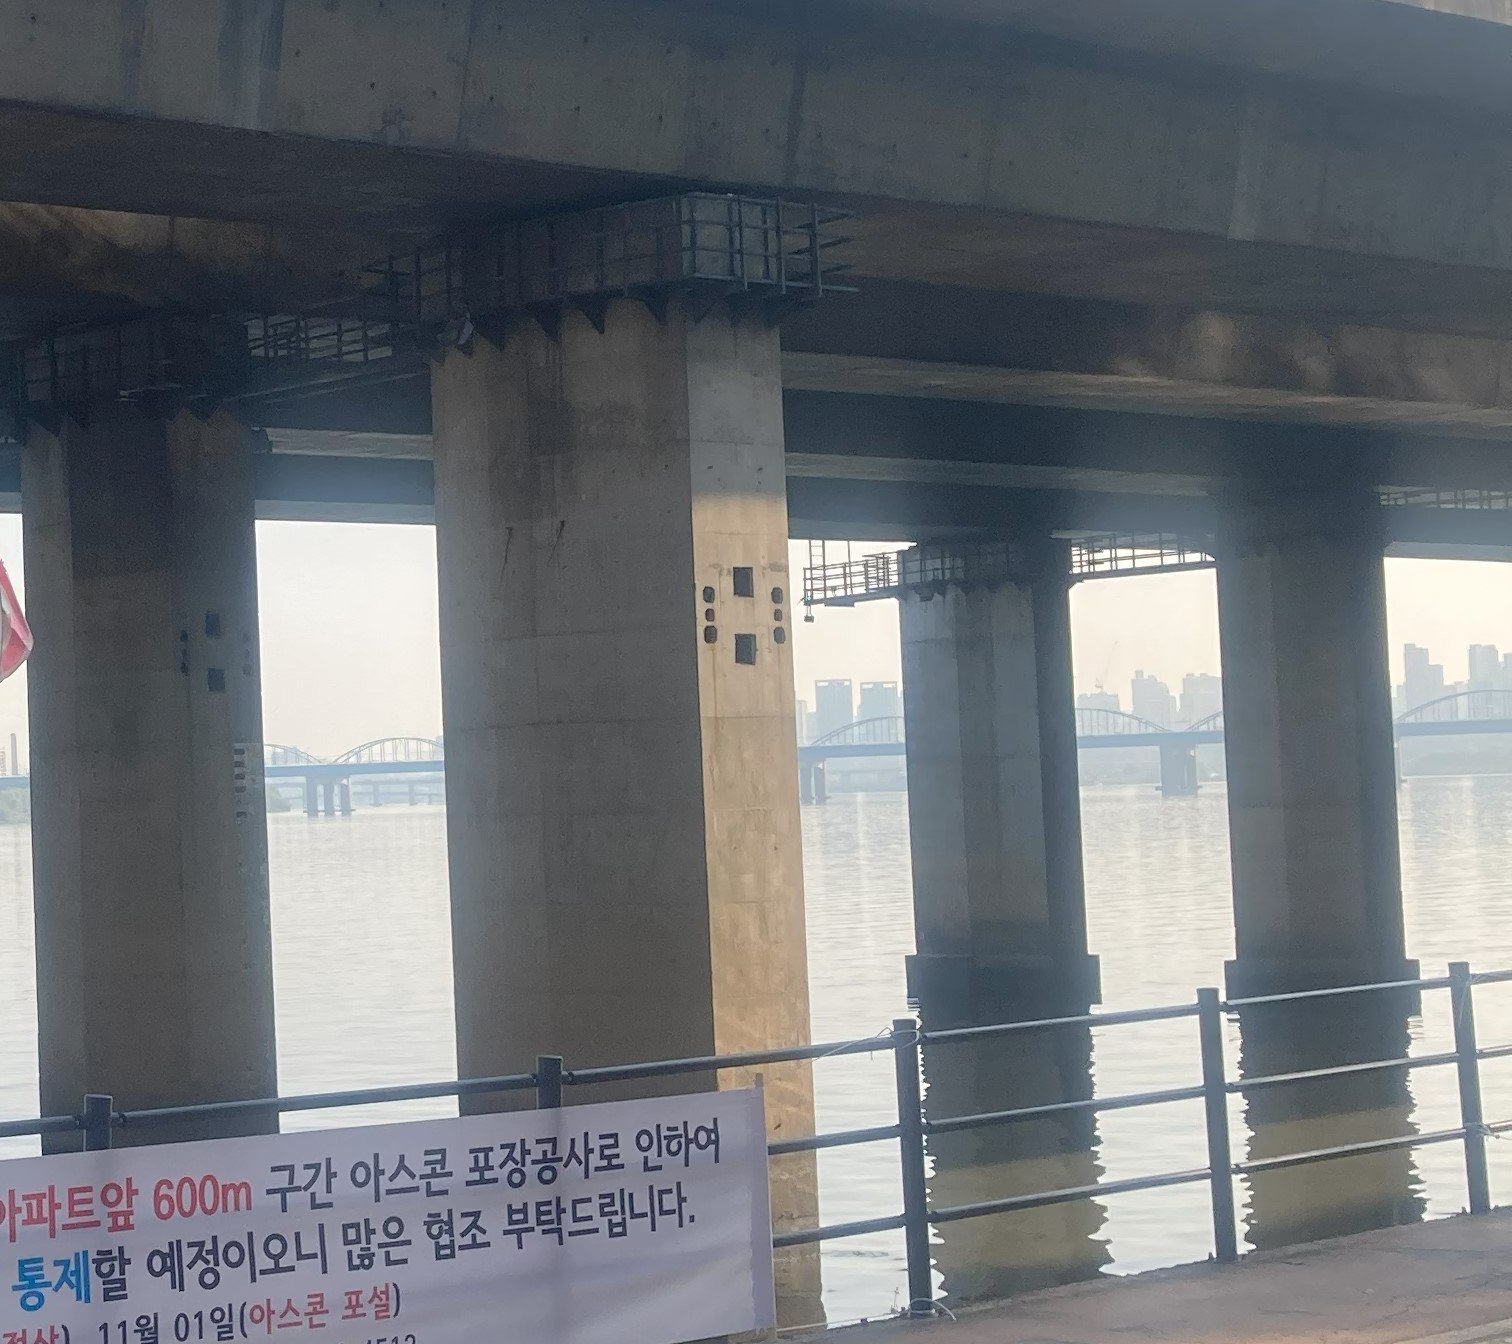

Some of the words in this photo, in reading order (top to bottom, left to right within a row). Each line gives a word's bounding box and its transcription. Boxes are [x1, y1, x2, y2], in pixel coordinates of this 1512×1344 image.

[152, 1174, 253, 1221] 600m
[265, 1157, 338, 1213] 구간
[349, 1147, 454, 1203] 아스콘
[464, 1131, 625, 1189] 포장공사로
[635, 1117, 720, 1173] 인하여
[10, 1245, 133, 1312] 통제할
[145, 1222, 329, 1292] 예정이오니
[340, 1214, 413, 1273] 많은
[423, 1208, 492, 1261] 협조
[502, 1181, 696, 1251] 부탁드립니다.
[173, 1291, 331, 1342] 01일(아스콘
[340, 1282, 401, 1322] 포설)
